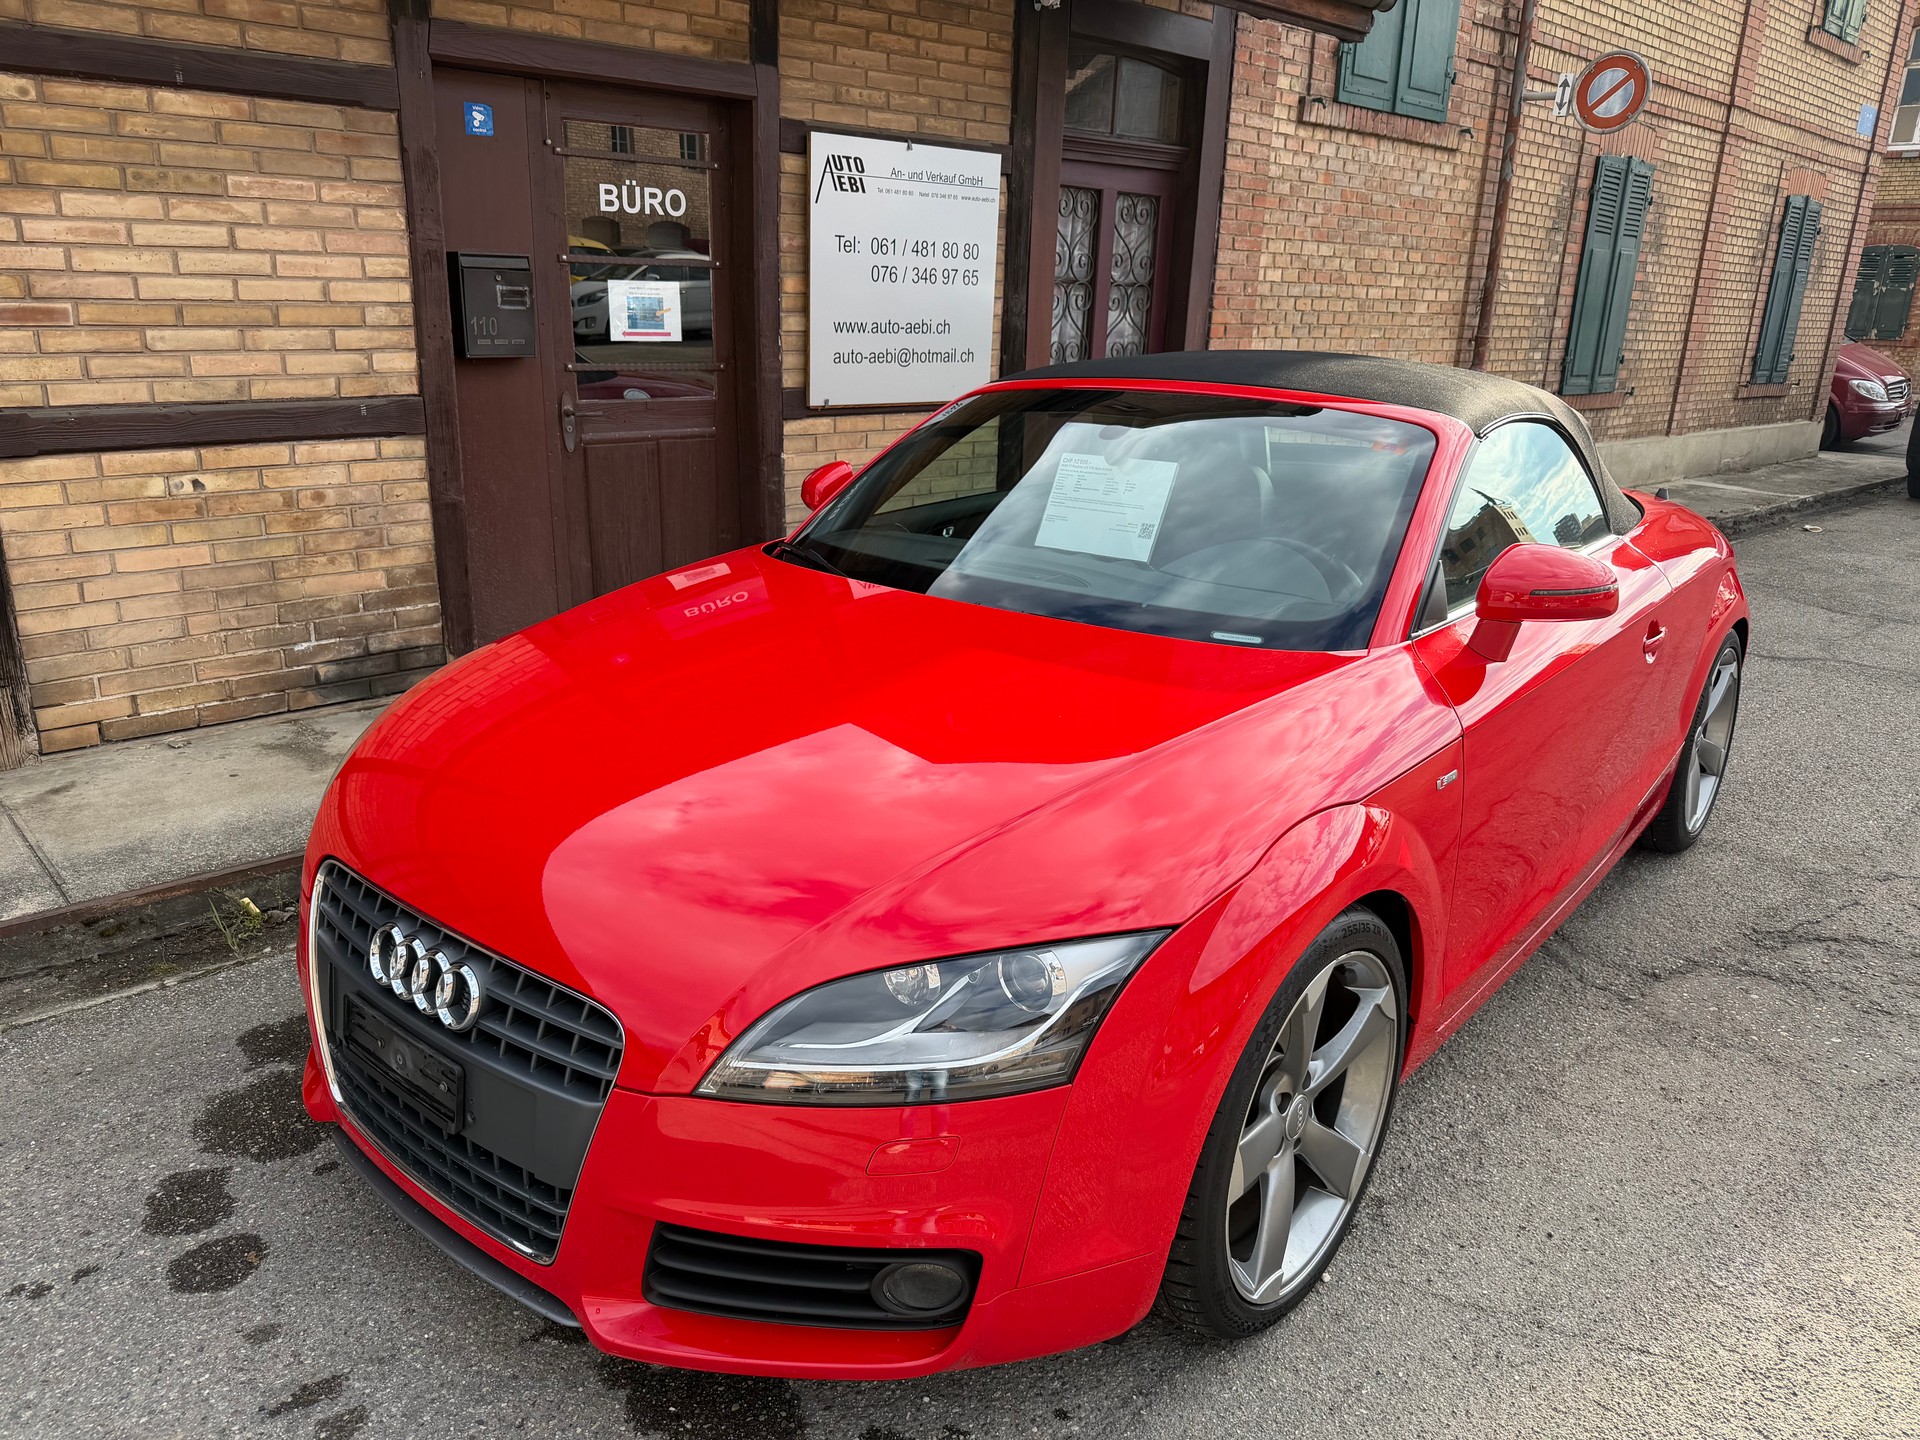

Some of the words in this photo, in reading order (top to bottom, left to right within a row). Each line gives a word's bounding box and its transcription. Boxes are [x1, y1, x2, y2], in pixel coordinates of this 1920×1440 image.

[890, 168, 905, 177] An-
[908, 171, 923, 180] und
[925, 173, 957, 183] Verkauf
[958, 176, 984, 186] GmbH
[599, 180, 687, 217] BÜRO
[835, 235, 861, 254] Tel:
[871, 237, 896, 255] 061
[902, 239, 908, 256] /
[911, 240, 936, 258] 481
[942, 242, 959, 259] 80
[963, 243, 980, 260] 80
[871, 265, 898, 283] 076
[902, 266, 908, 283] /
[911, 267, 937, 285] 346
[941, 269, 958, 285] 97
[962, 270, 979, 286] 65
[471, 316, 498, 336] 110
[833, 319, 951, 334] www.auto-aebi.ch
[833, 348, 975, 367] auto-aebi@hotmail.ch
[1342, 922, 1371, 939] 255/35
